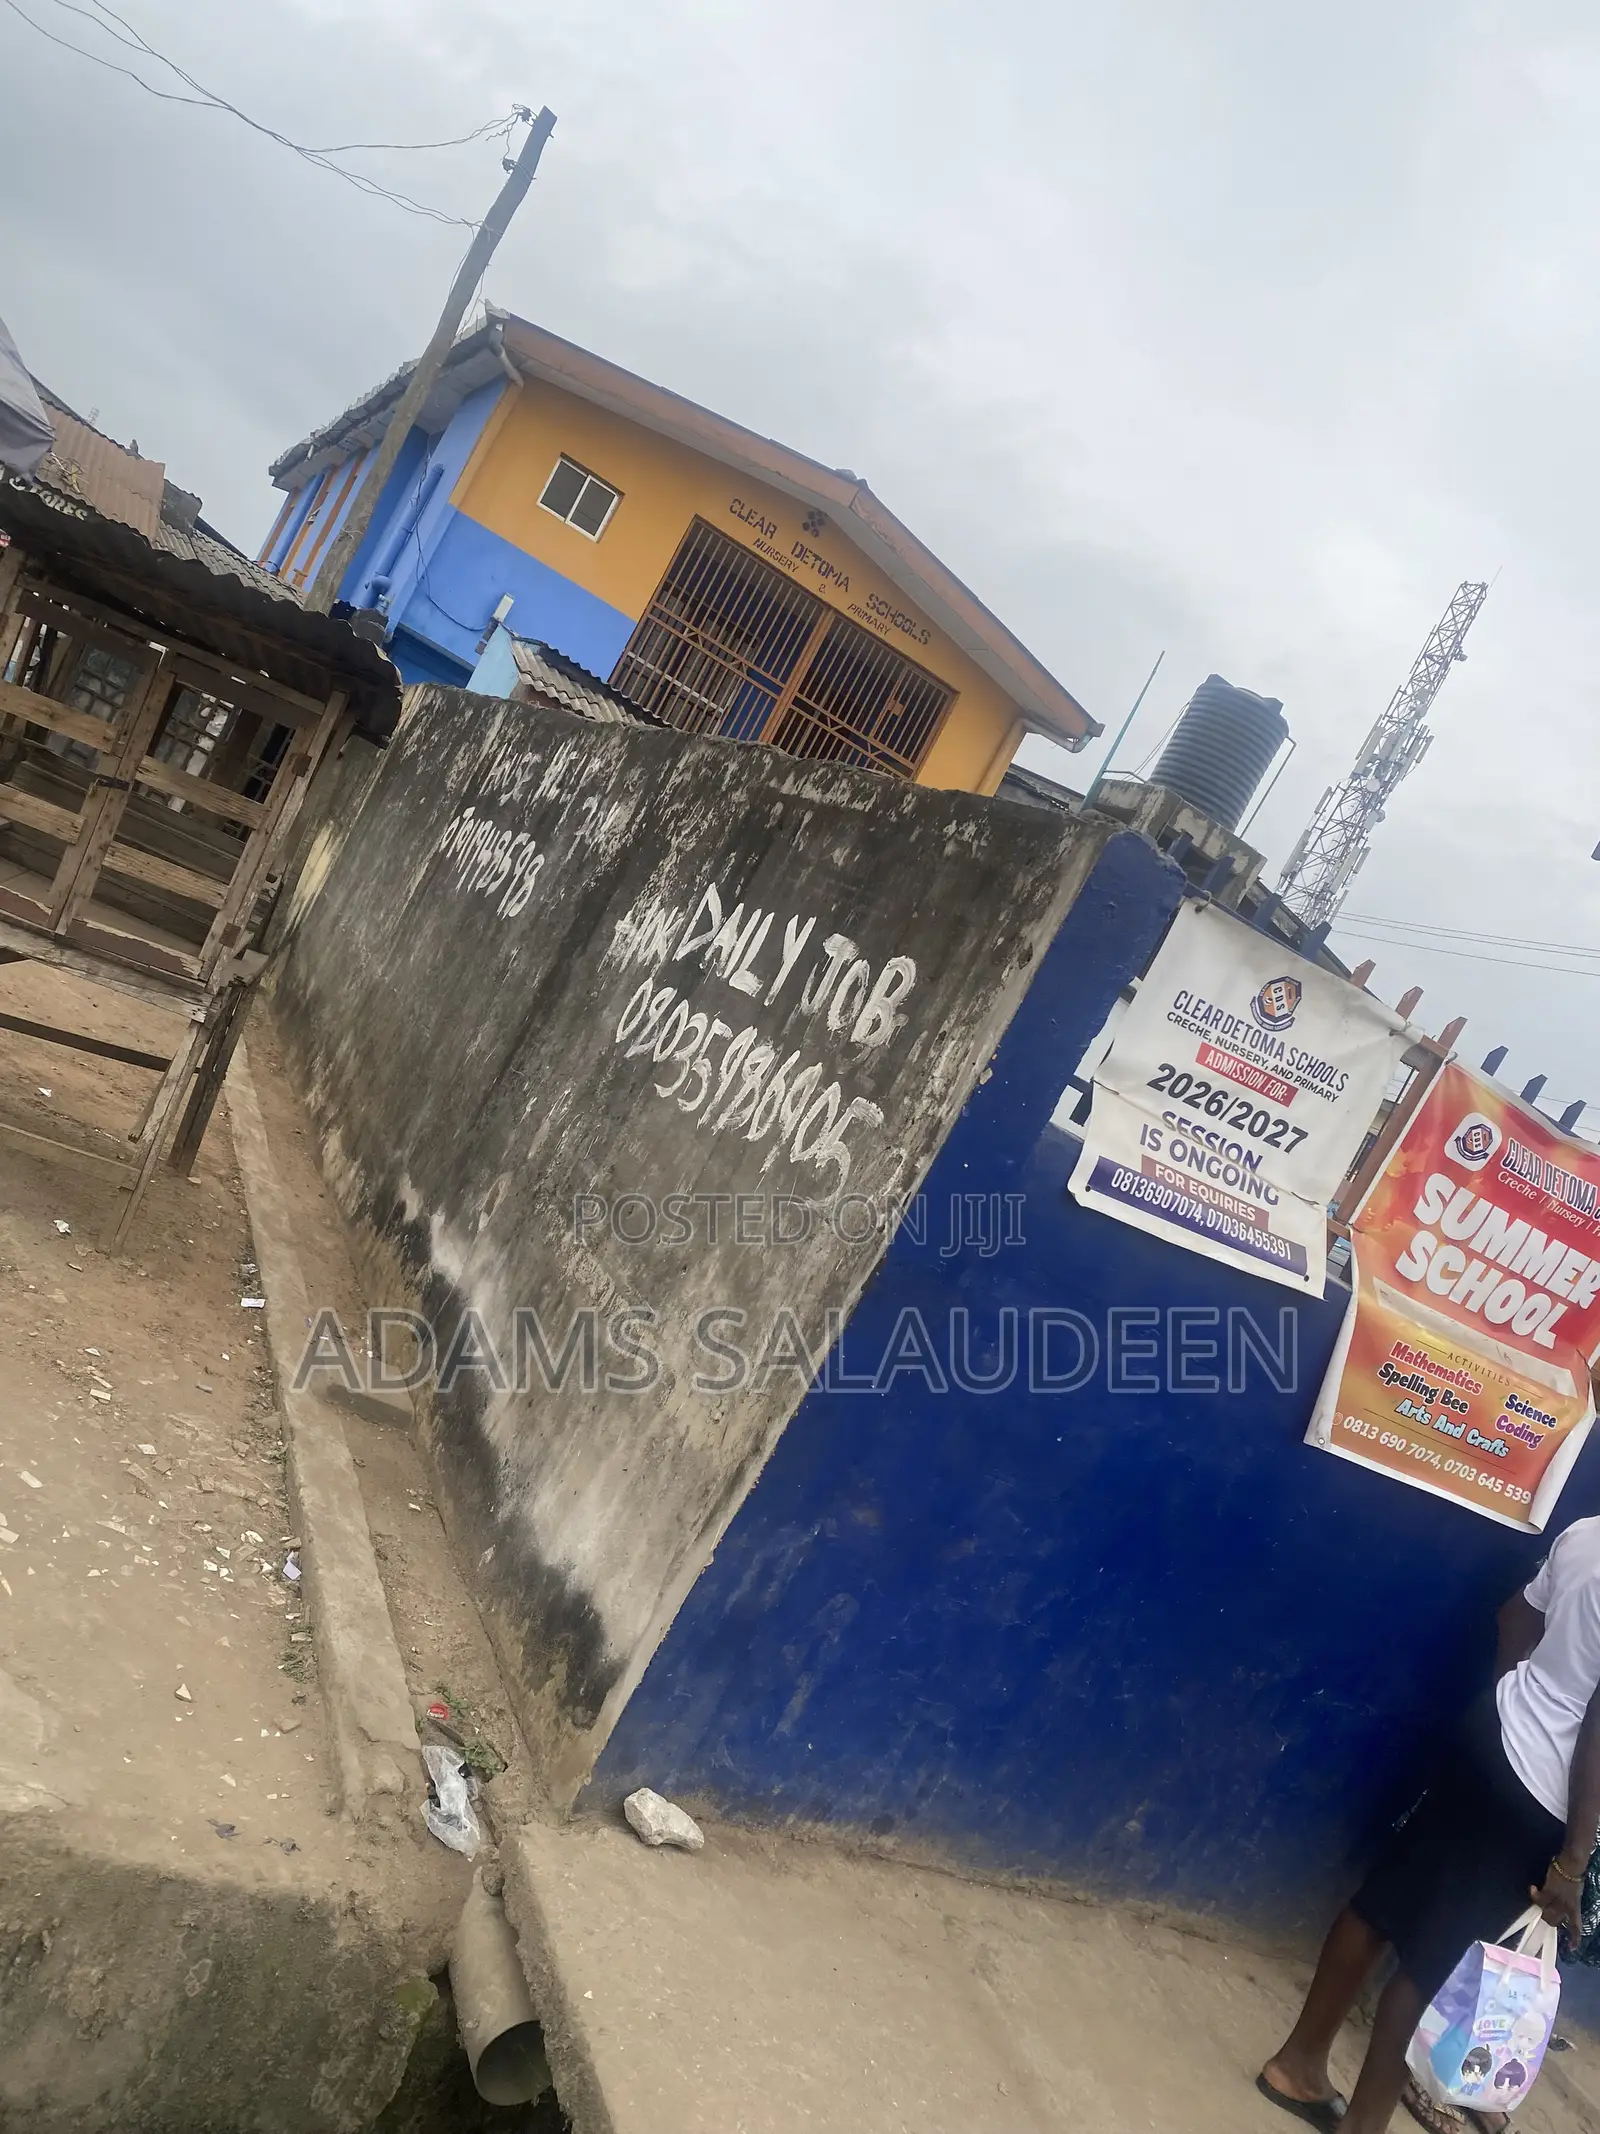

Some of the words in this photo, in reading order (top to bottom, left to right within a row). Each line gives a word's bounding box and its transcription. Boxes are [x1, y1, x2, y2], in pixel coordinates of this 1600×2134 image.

[729, 498, 777, 540] CLEAR
[791, 540, 851, 593] DETOMA
[866, 592, 931, 646] SCHOOLS
[753, 537, 799, 573] NURSERY
[818, 583, 826, 594] &
[847, 603, 892, 636] PRIMARY
[672, 882, 817, 1006] DAILY
[801, 932, 917, 1048] JOB
[1167, 1011, 1211, 1043] CRECHE,
[1215, 1035, 1268, 1071] NURSERY,
[1271, 1063, 1294, 1080] AND
[1293, 1075, 1339, 1103] PRIMARY
[1173, 990, 1225, 1031] CLEAR
[1221, 1014, 1286, 1062] DETOMA
[1286, 1047, 1349, 1092] SCHOOLS
[1205, 1049, 1266, 1089] ADMISSION
[1265, 1081, 1287, 1102] FOR:
[1147, 1063, 1309, 1154] 2026/2027
[1162, 1110, 1263, 1174] SESSION
[1140, 1124, 1164, 1152] IS
[1169, 1139, 1280, 1206] ONGOING
[1155, 1164, 1185, 1190] FOR
[1190, 1181, 1256, 1222] EQUIRIES
[1497, 1171, 1538, 1200] Creche
[1546, 1199, 1586, 1228] Nursery
[1501, 1137, 1542, 1188] CLEAR
[1542, 1160, 1598, 1217] DETOMA
[1111, 1168, 1204, 1226] 08136907074,
[1206, 1208, 1292, 1260] 07036455391
[1413, 1172, 1600, 1309] SUMMER
[1395, 1230, 1568, 1349] SCHOOL
[1377, 1362, 1440, 1406] Spelling
[1440, 1388, 1469, 1415] Bee
[1390, 1340, 1483, 1396] Mathematics
[1447, 1352, 1511, 1387] ACTIVITIES
[1394, 1398, 1432, 1426] Arts
[1432, 1413, 1464, 1439] And
[1464, 1428, 1510, 1459] Crafts
[1495, 1414, 1545, 1450] Coding
[1504, 1393, 1558, 1429] Science
[1343, 1415, 1380, 1441] 0813
[1379, 1430, 1407, 1453] 690
[1405, 1442, 1441, 1470] 7074,
[1444, 1458, 1477, 1483] 0703
[1477, 1472, 1505, 1494] 645
[1503, 1482, 1532, 1506] 539
